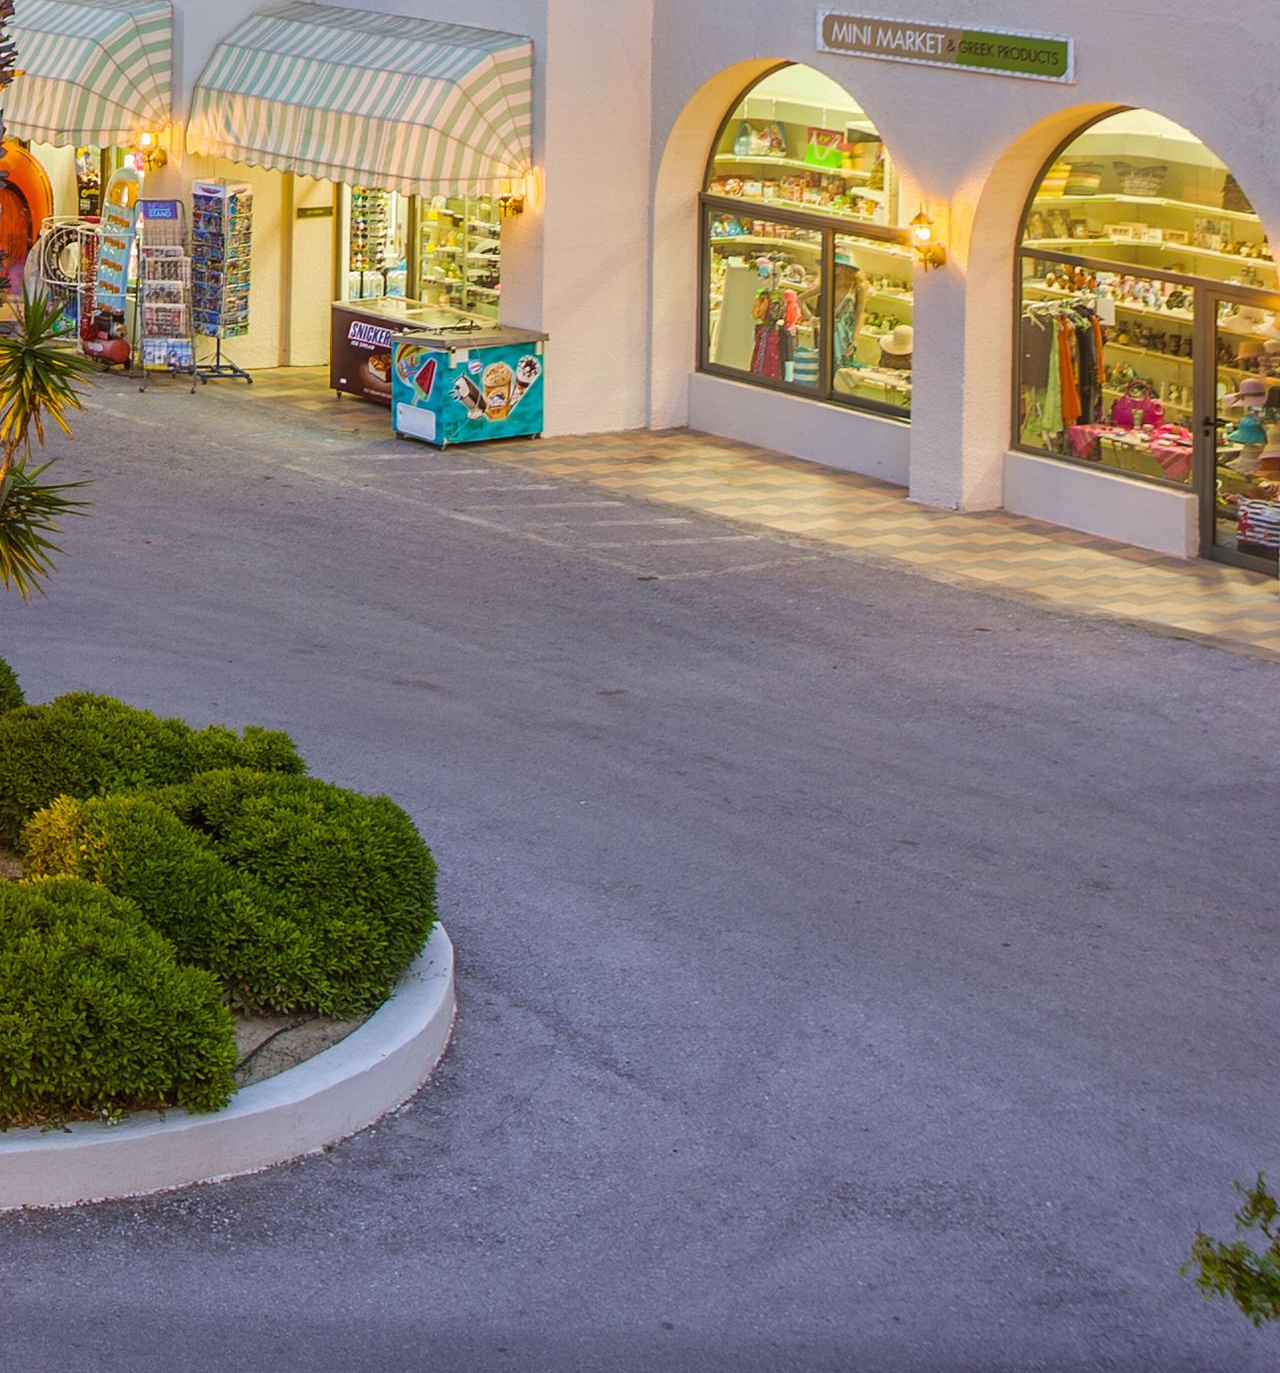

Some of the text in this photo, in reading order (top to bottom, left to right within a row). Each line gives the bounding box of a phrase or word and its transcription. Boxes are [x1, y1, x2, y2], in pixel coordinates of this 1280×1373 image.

[831, 21, 1060, 66] MINI MARKET & GREEK PRODUCTS
